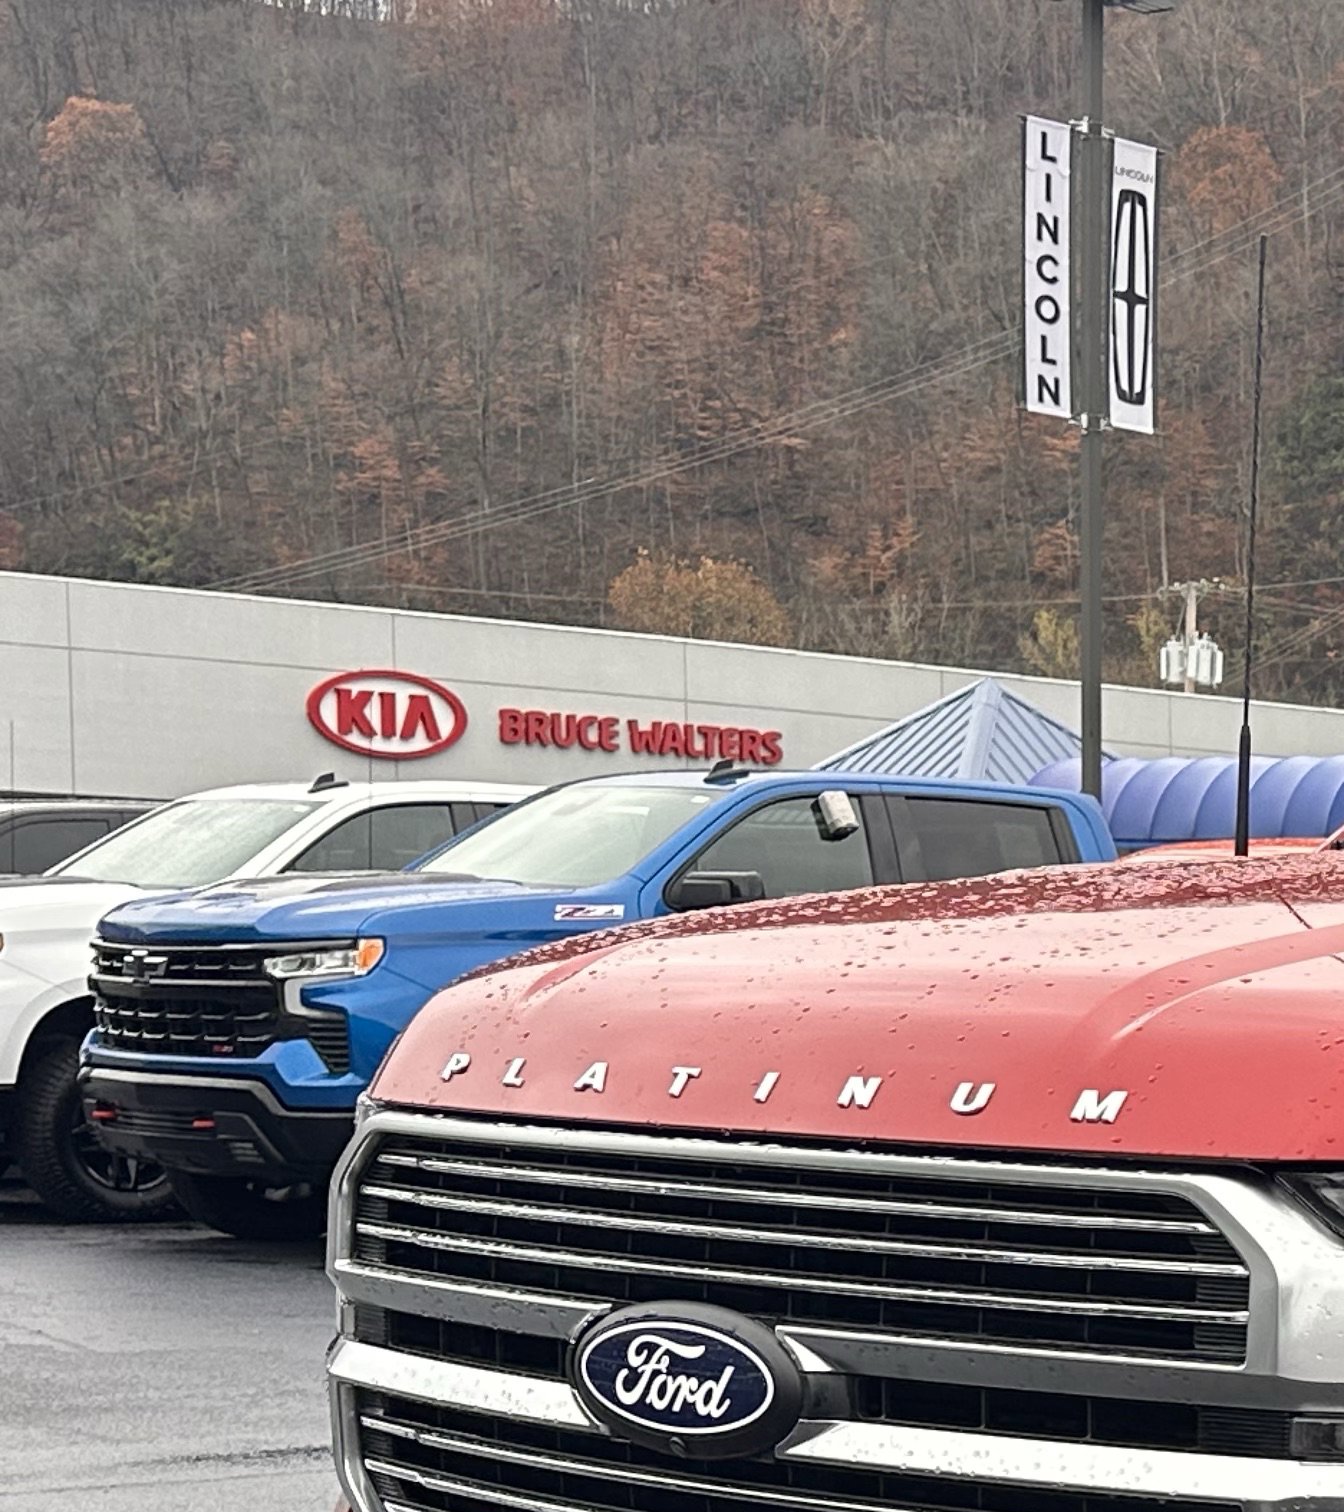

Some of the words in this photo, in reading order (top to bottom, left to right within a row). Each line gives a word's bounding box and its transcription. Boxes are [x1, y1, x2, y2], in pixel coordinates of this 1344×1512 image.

[1034, 131, 1061, 406] LINCOLN
[333, 687, 443, 742] KIA
[498, 708, 620, 752] BRUCE
[626, 719, 784, 766] WALTERS
[439, 1052, 1129, 1124] PLATINUM
[615, 1334, 736, 1418] Ford
